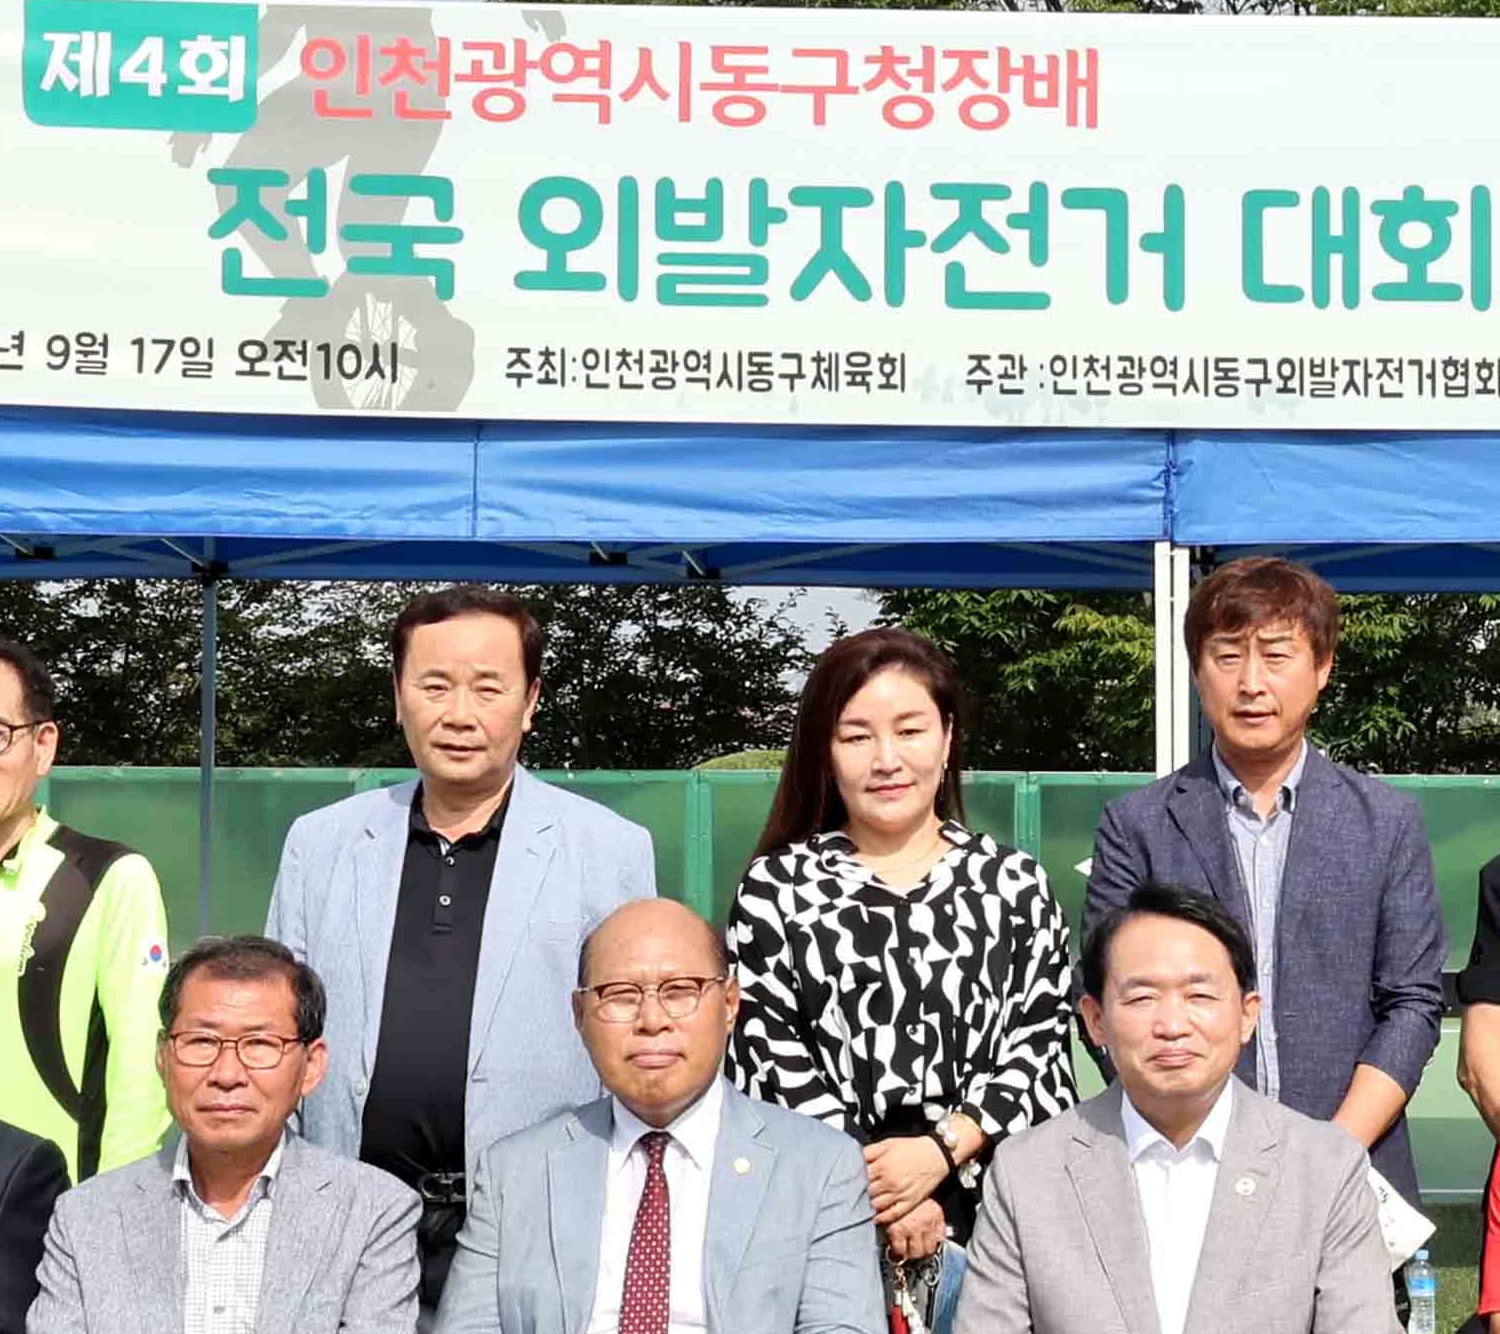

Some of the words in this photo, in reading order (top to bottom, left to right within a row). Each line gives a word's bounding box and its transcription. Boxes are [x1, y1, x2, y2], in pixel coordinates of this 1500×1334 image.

[41, 31, 247, 102] 제4회
[300, 33, 1099, 131] 인천광역시동구청장배
[206, 167, 464, 301] 전국
[514, 175, 1186, 311] 외발자전거
[1241, 185, 1493, 312] 대회
[46, 332, 110, 376] 9월
[130, 336, 214, 380] 17일
[235, 338, 399, 384] 오전10시
